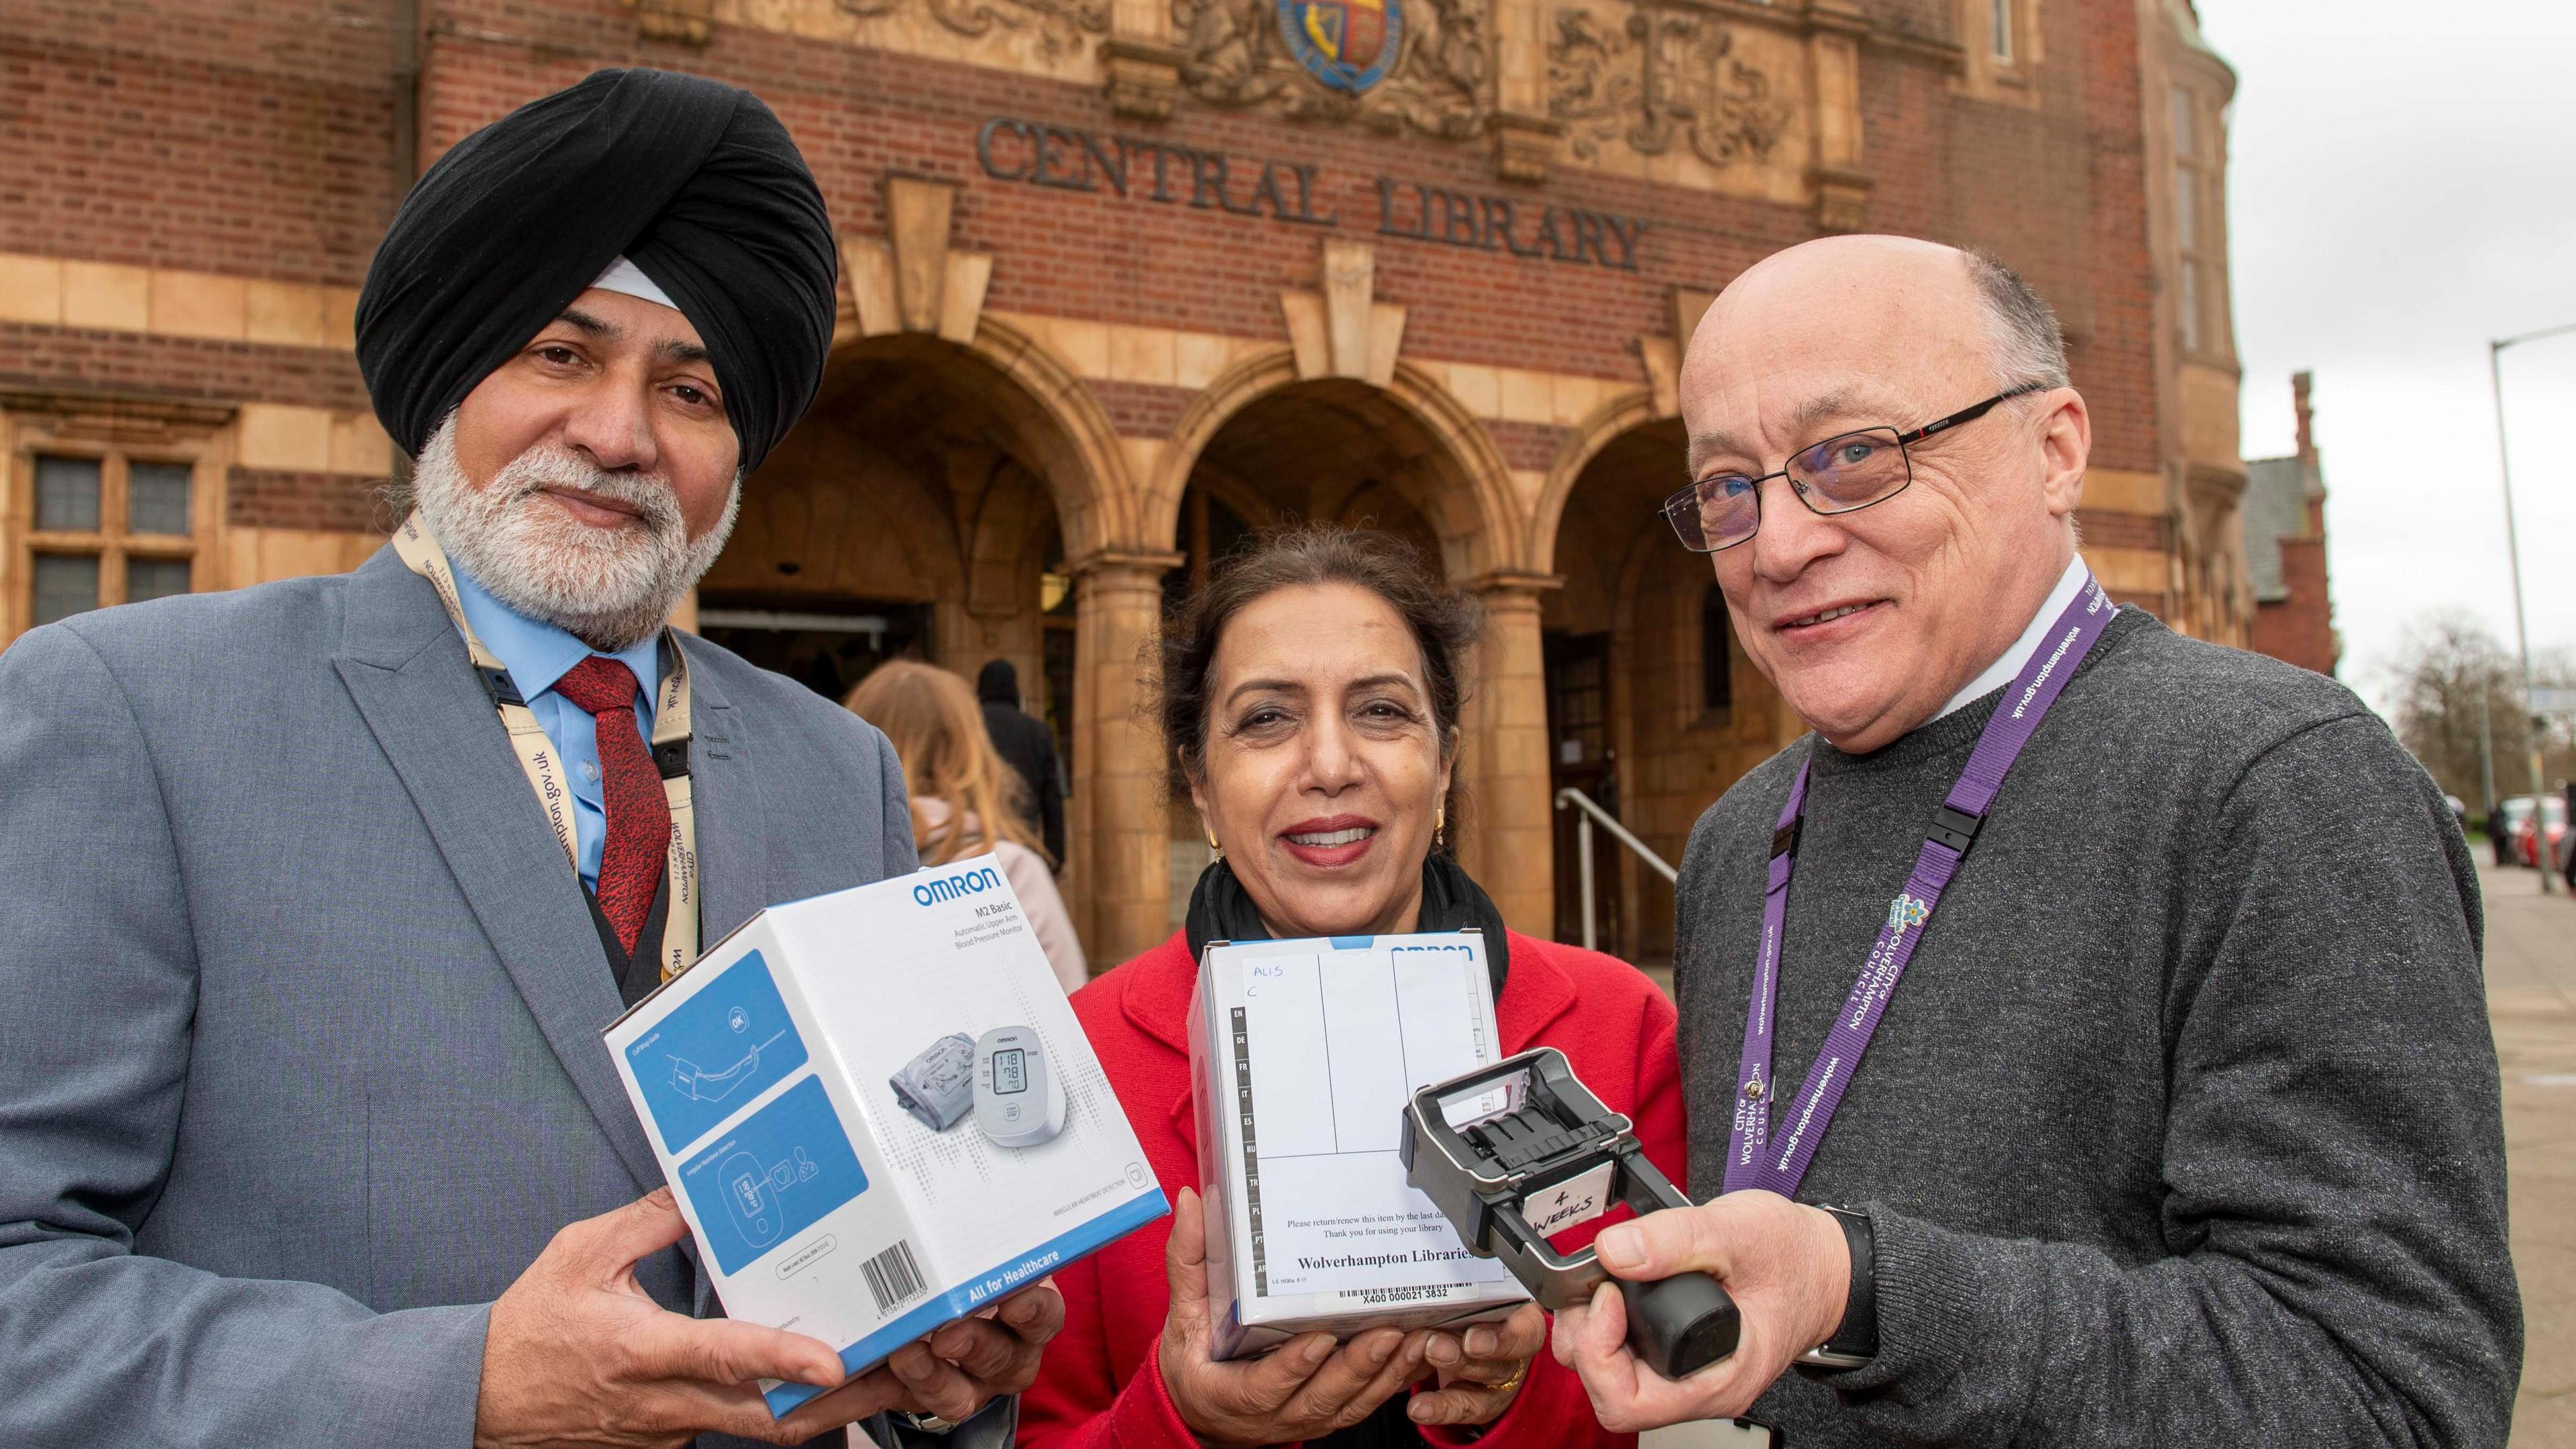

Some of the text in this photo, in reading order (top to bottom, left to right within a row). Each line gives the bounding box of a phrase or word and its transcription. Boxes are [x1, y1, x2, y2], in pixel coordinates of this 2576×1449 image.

[977, 117, 1650, 272] CENTRAL LIBRARY
[2012, 626, 2082, 719] wolverhampton.gov.uk
[672, 822, 688, 904] WOLVERHAMPTON
[686, 851, 694, 871] CITY
[913, 867, 1001, 906] OMRON
[975, 902, 1013, 918] M2 Basic
[1894, 895, 1906, 931] Dementia
[955, 914, 1018, 938] Automatic Upper Arm
[955, 924, 1023, 950] Blood Pressure Monitor
[1758, 924, 1774, 1035] wolverhampton.gov.uk
[1851, 941, 1885, 1002] COUNCIL
[1885, 965, 1898, 990] CITY
[1246, 985, 1258, 998] C
[732, 1014, 745, 1029] OK
[1234, 1010, 1243, 1018] EN
[1236, 1036, 1246, 1044] DE
[1000, 1053, 1018, 1066] 118
[1239, 1063, 1248, 1071] FR
[1004, 1066, 1019, 1079] 78
[1008, 1079, 1020, 1089] 70
[1241, 1090, 1248, 1098] IT
[1244, 1118, 1252, 1126] ES
[1735, 1108, 1747, 1131] CITY
[1741, 1063, 1761, 1166] WOLVERHAON
[1778, 1057, 1839, 1173] wolverhampton.gov.uk
[1246, 1145, 1256, 1153] RU
[1249, 1179, 1258, 1187] TR
[1053, 1178, 1126, 1217] IRREGULAR HEARTBEAT DETECTION
[1555, 1191, 1569, 1206] 4
[1287, 1210, 1446, 1228] Please return/renew this item by the last da
[1534, 1196, 1593, 1232] WEEKS
[1324, 1223, 1443, 1239] Thank you for using your library
[1297, 1247, 1474, 1271] Wolverhampton Libraries
[969, 1250, 1060, 1303] All for Healthcare
[1362, 1288, 1448, 1304] X400 000021 3832
